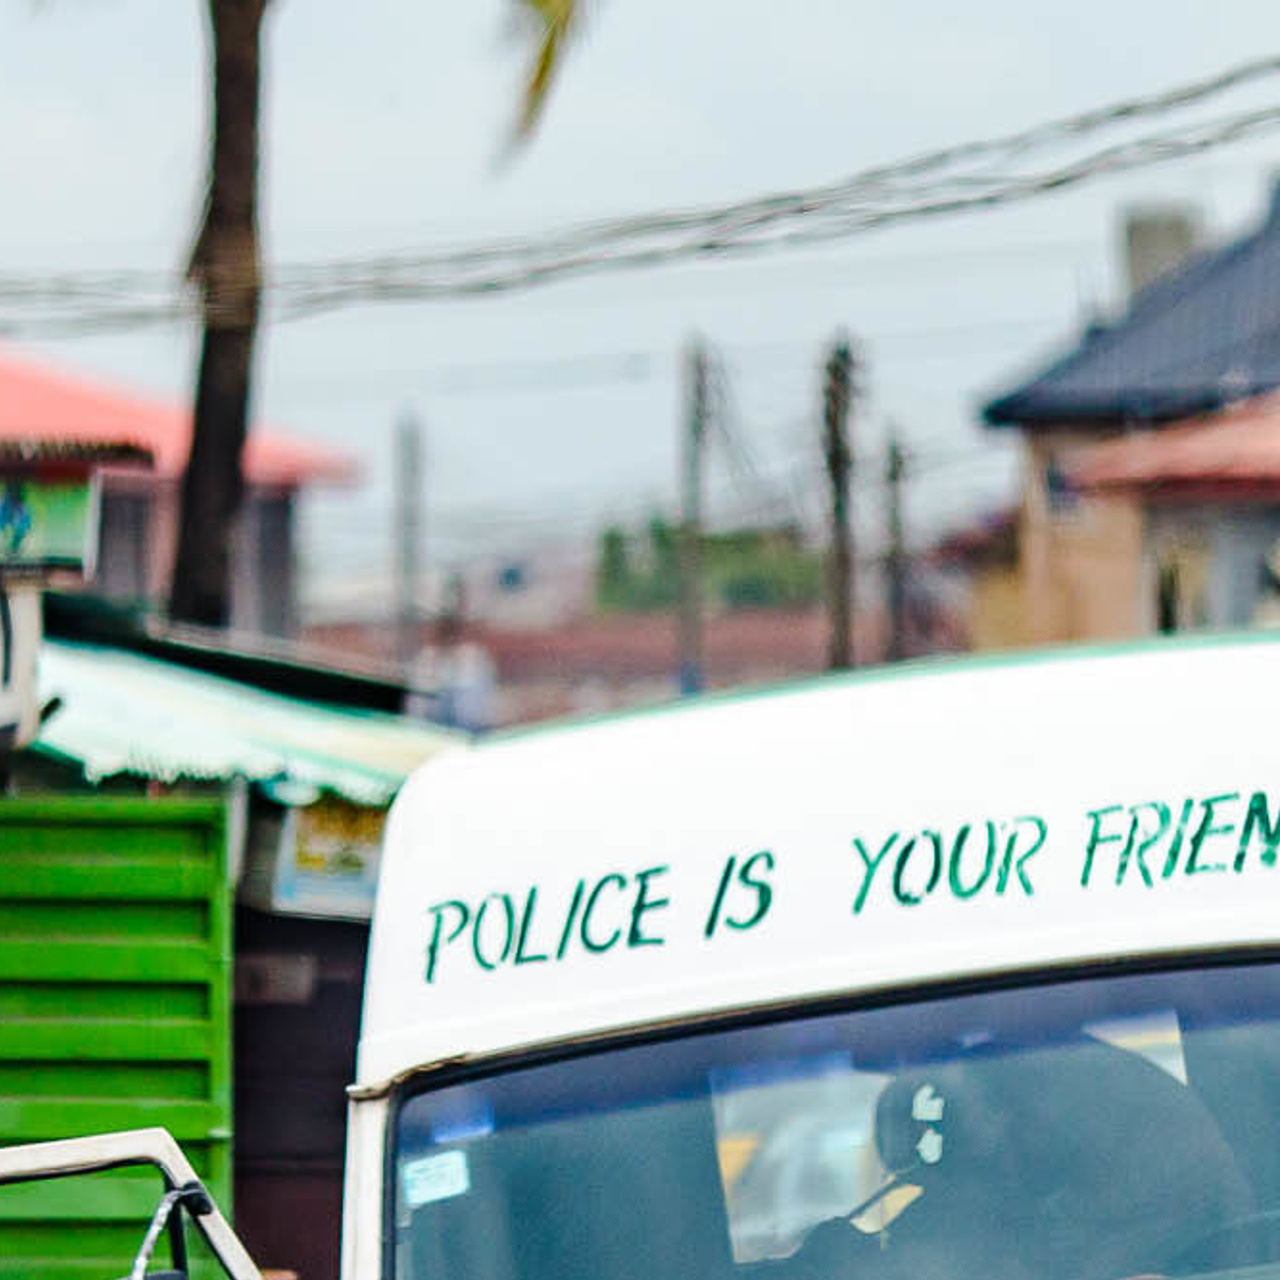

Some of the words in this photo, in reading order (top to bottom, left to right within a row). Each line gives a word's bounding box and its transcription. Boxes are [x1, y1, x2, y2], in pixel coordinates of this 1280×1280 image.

[424, 865, 670, 985] POLICE
[705, 850, 776, 939] IS
[852, 815, 1048, 917] YOUR
